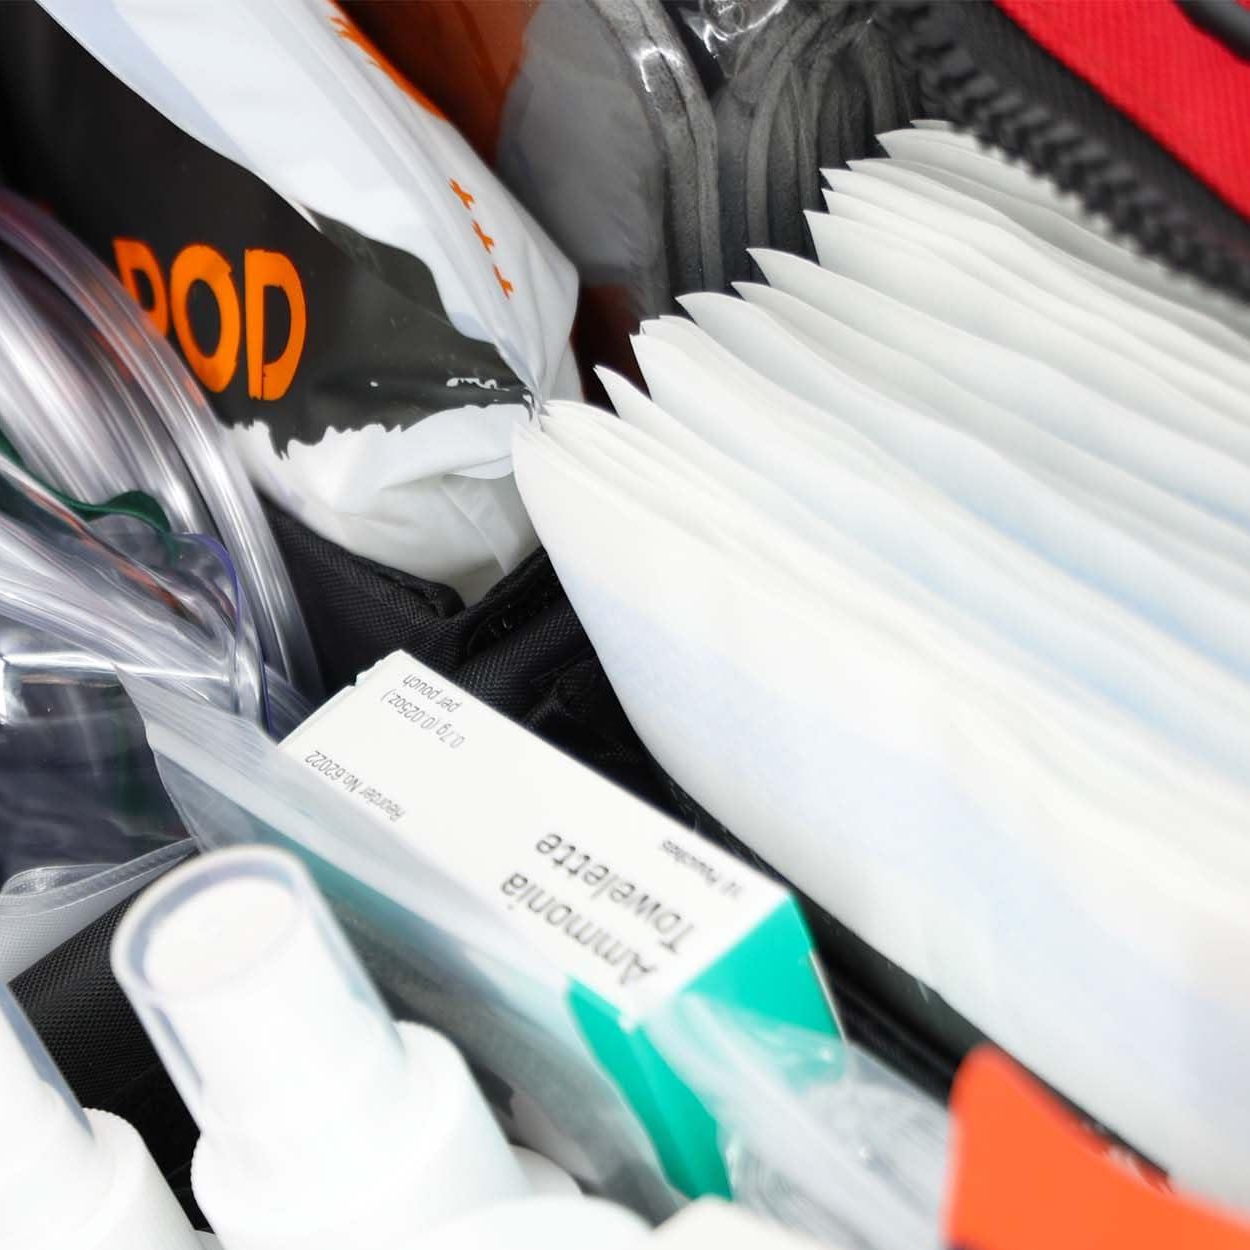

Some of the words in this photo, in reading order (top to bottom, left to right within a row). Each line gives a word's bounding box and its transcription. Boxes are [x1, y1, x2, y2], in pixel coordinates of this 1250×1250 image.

[112, 237, 308, 401] POD
[402, 673, 444, 701] pouch
[435, 697, 463, 714] per
[500, 871, 657, 986] Ammonia
[535, 832, 695, 954] Towelette
